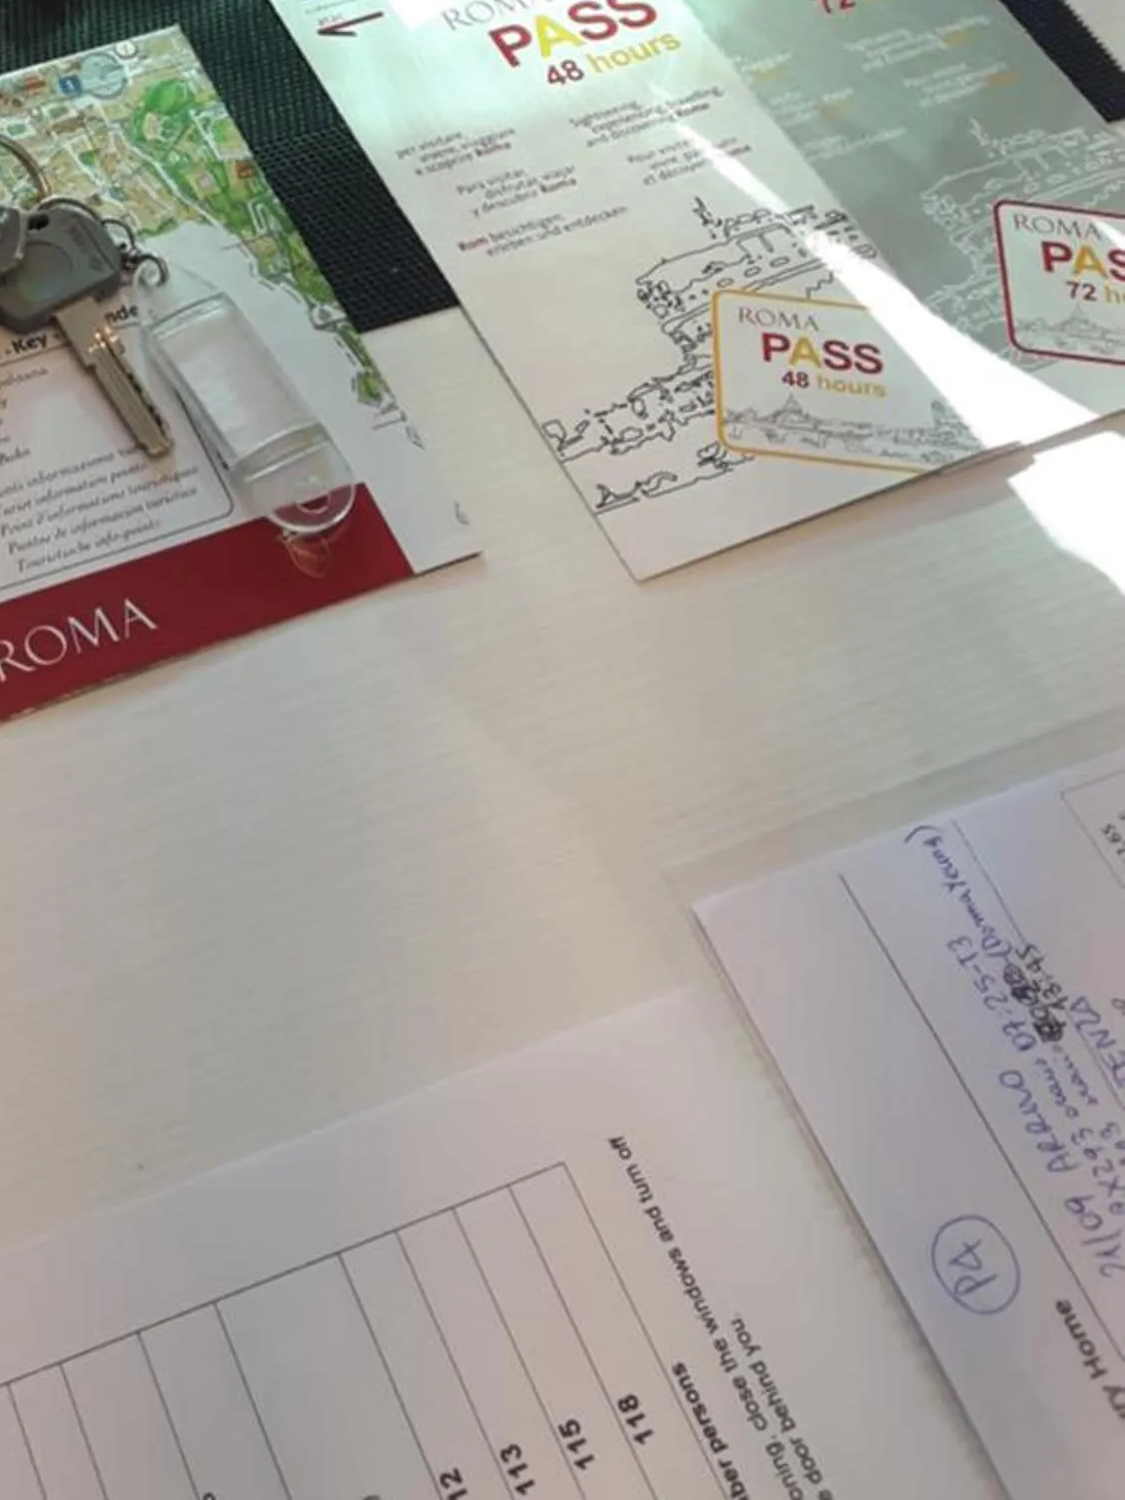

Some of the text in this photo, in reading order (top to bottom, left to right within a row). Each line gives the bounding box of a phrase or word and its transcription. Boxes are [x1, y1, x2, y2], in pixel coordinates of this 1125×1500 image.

[546, 29, 681, 86] 48 hours
[1013, 213, 1102, 241] ROMA
[1067, 280, 1097, 302] 72
[739, 306, 819, 332] ROMA
[11, 331, 50, 357] Key
[761, 333, 884, 375] PASS
[781, 371, 886, 398] 48 hours
[607, 1132, 634, 1163] off
[623, 1161, 656, 1205] turn
[643, 1203, 676, 1245] and
[666, 1246, 722, 1336] windows
[950, 1238, 998, 1296] P4
[708, 1334, 740, 1374] the
[1055, 1299, 1107, 1380] Home
[618, 1393, 655, 1446] 118
[671, 1361, 729, 1456] persons
[727, 1313, 826, 1488] door behind you.
[727, 1372, 771, 1434] close
[558, 1418, 595, 1472] 115
[499, 1443, 537, 1496] 113
